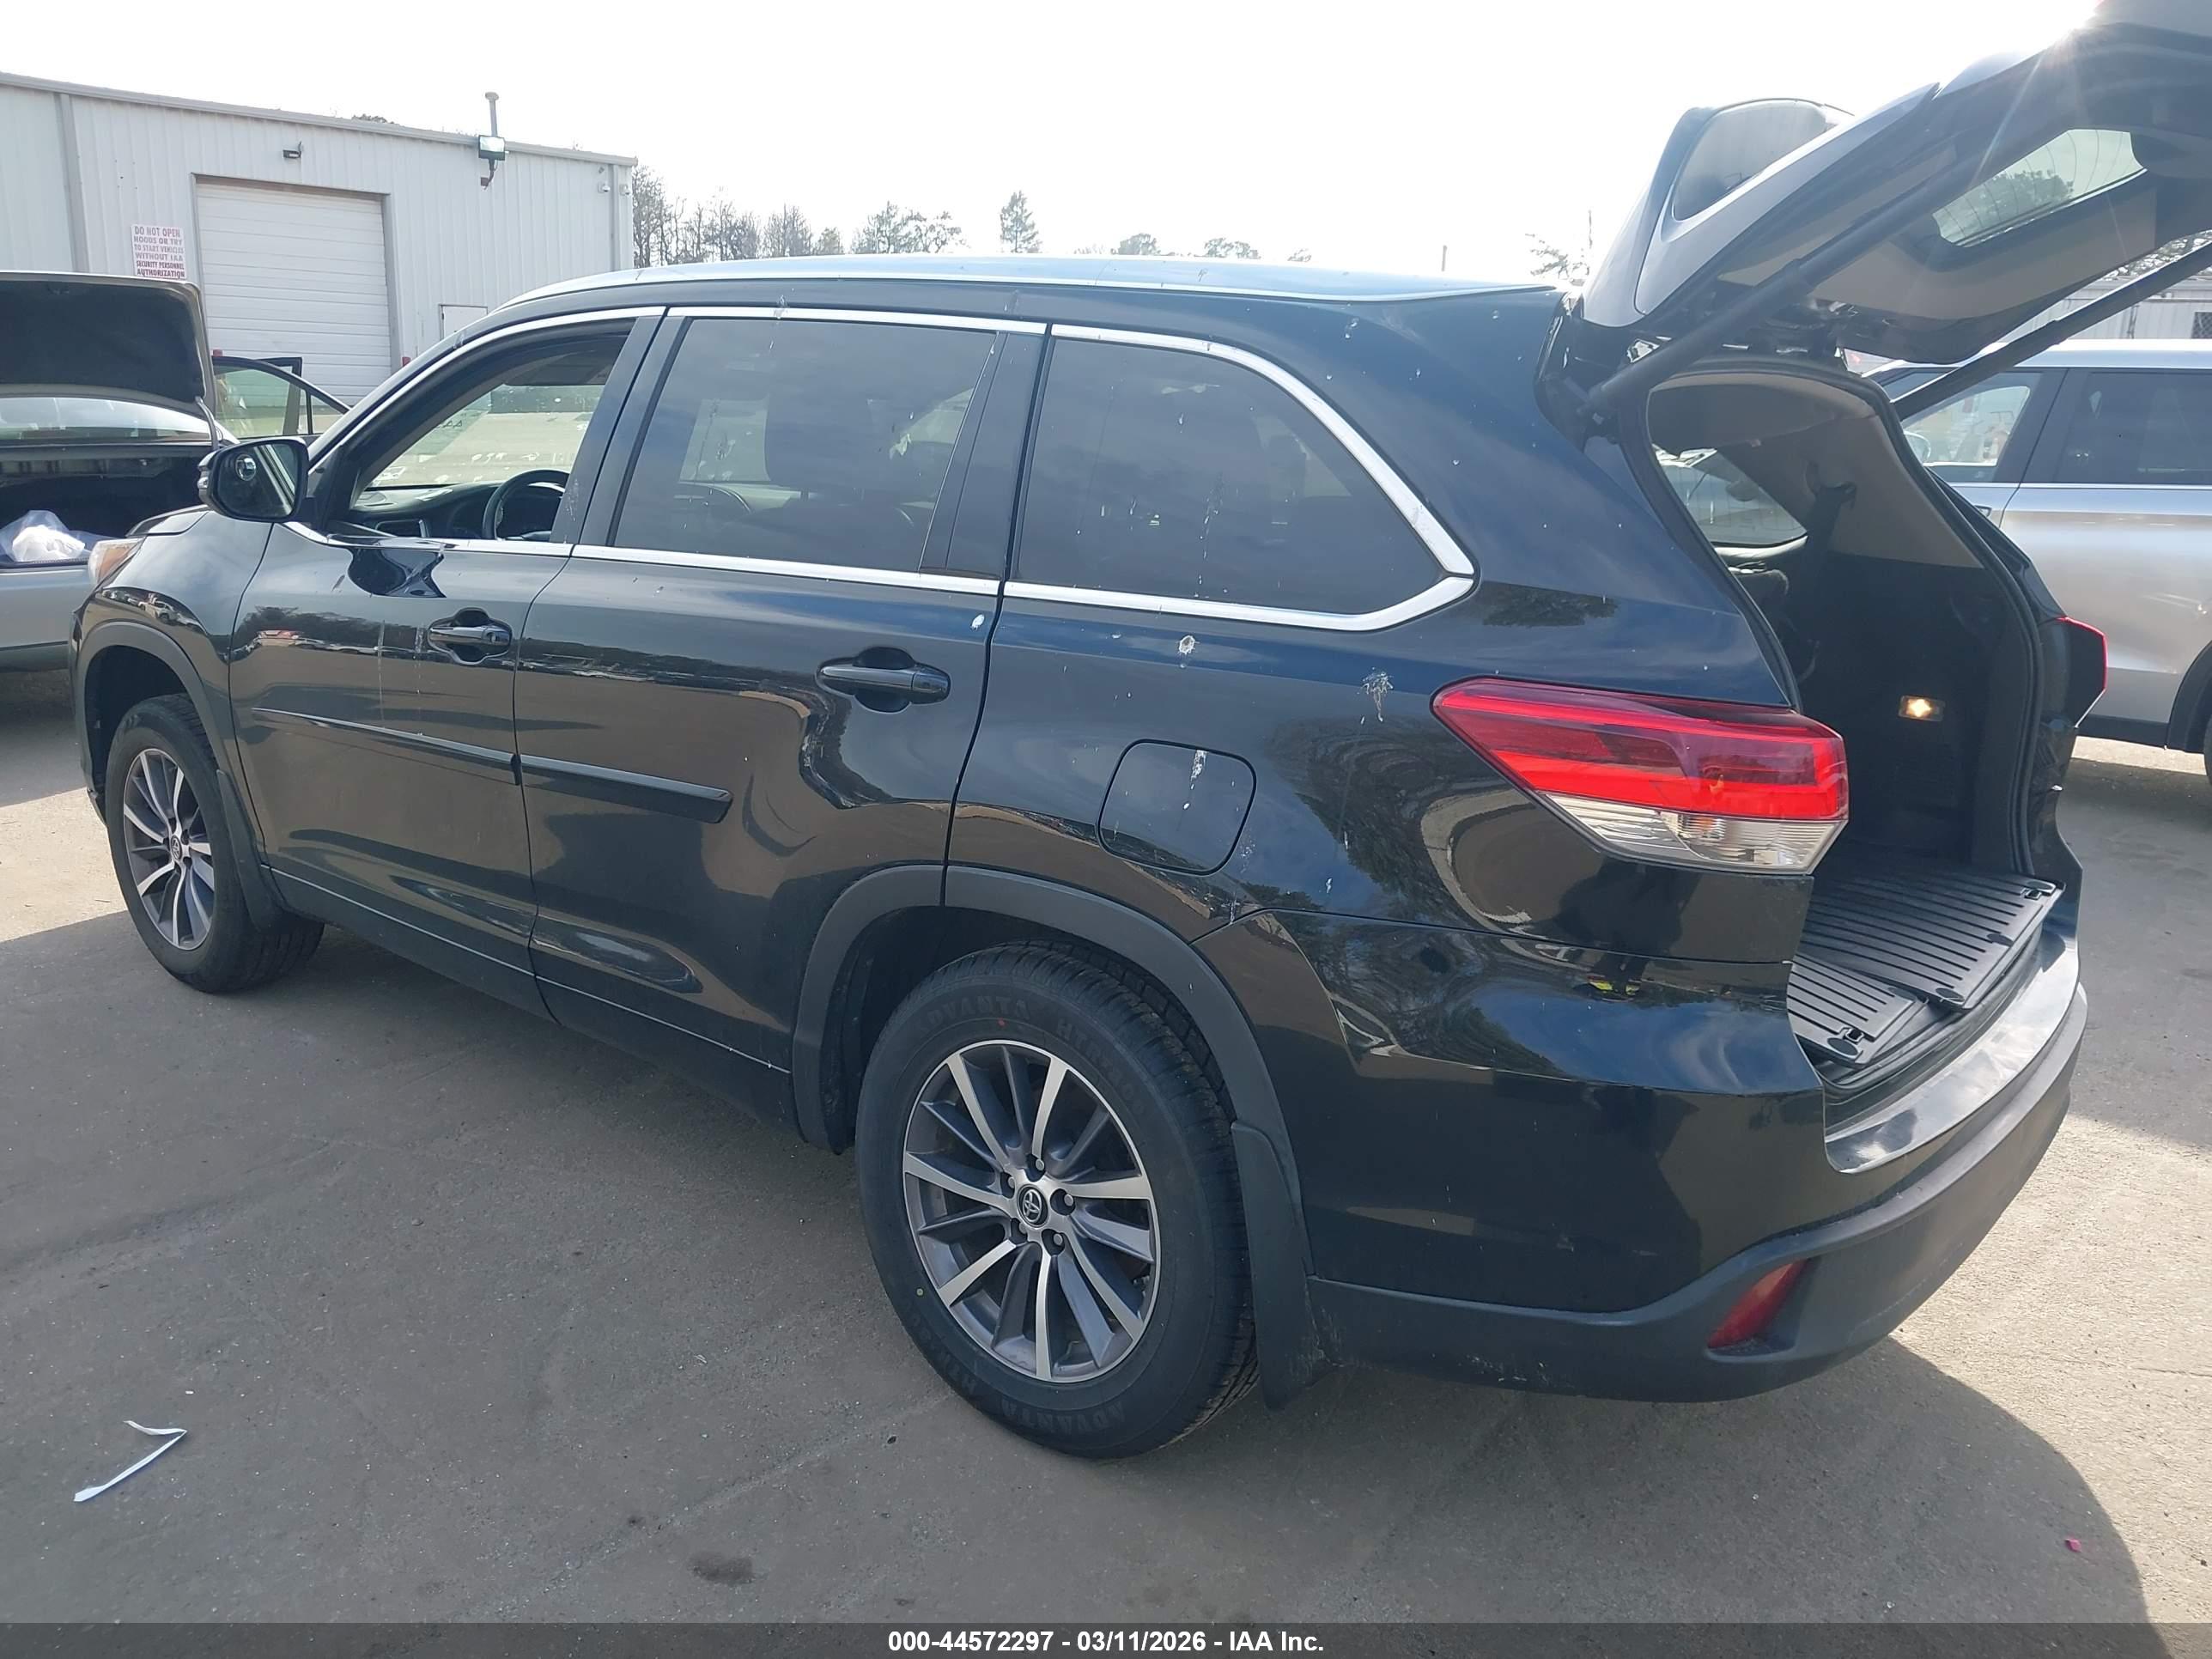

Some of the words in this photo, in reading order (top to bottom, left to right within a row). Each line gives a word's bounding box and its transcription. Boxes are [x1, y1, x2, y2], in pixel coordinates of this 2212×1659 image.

[135, 226, 144, 234] DO
[147, 227, 160, 236] NOT
[162, 228, 180, 237] OPEN
[134, 235, 157, 244] HOODS
[161, 246, 184, 254] VEHICLES
[137, 260, 158, 269] SECURITY
[137, 268, 185, 277] AUTHORIZATION
